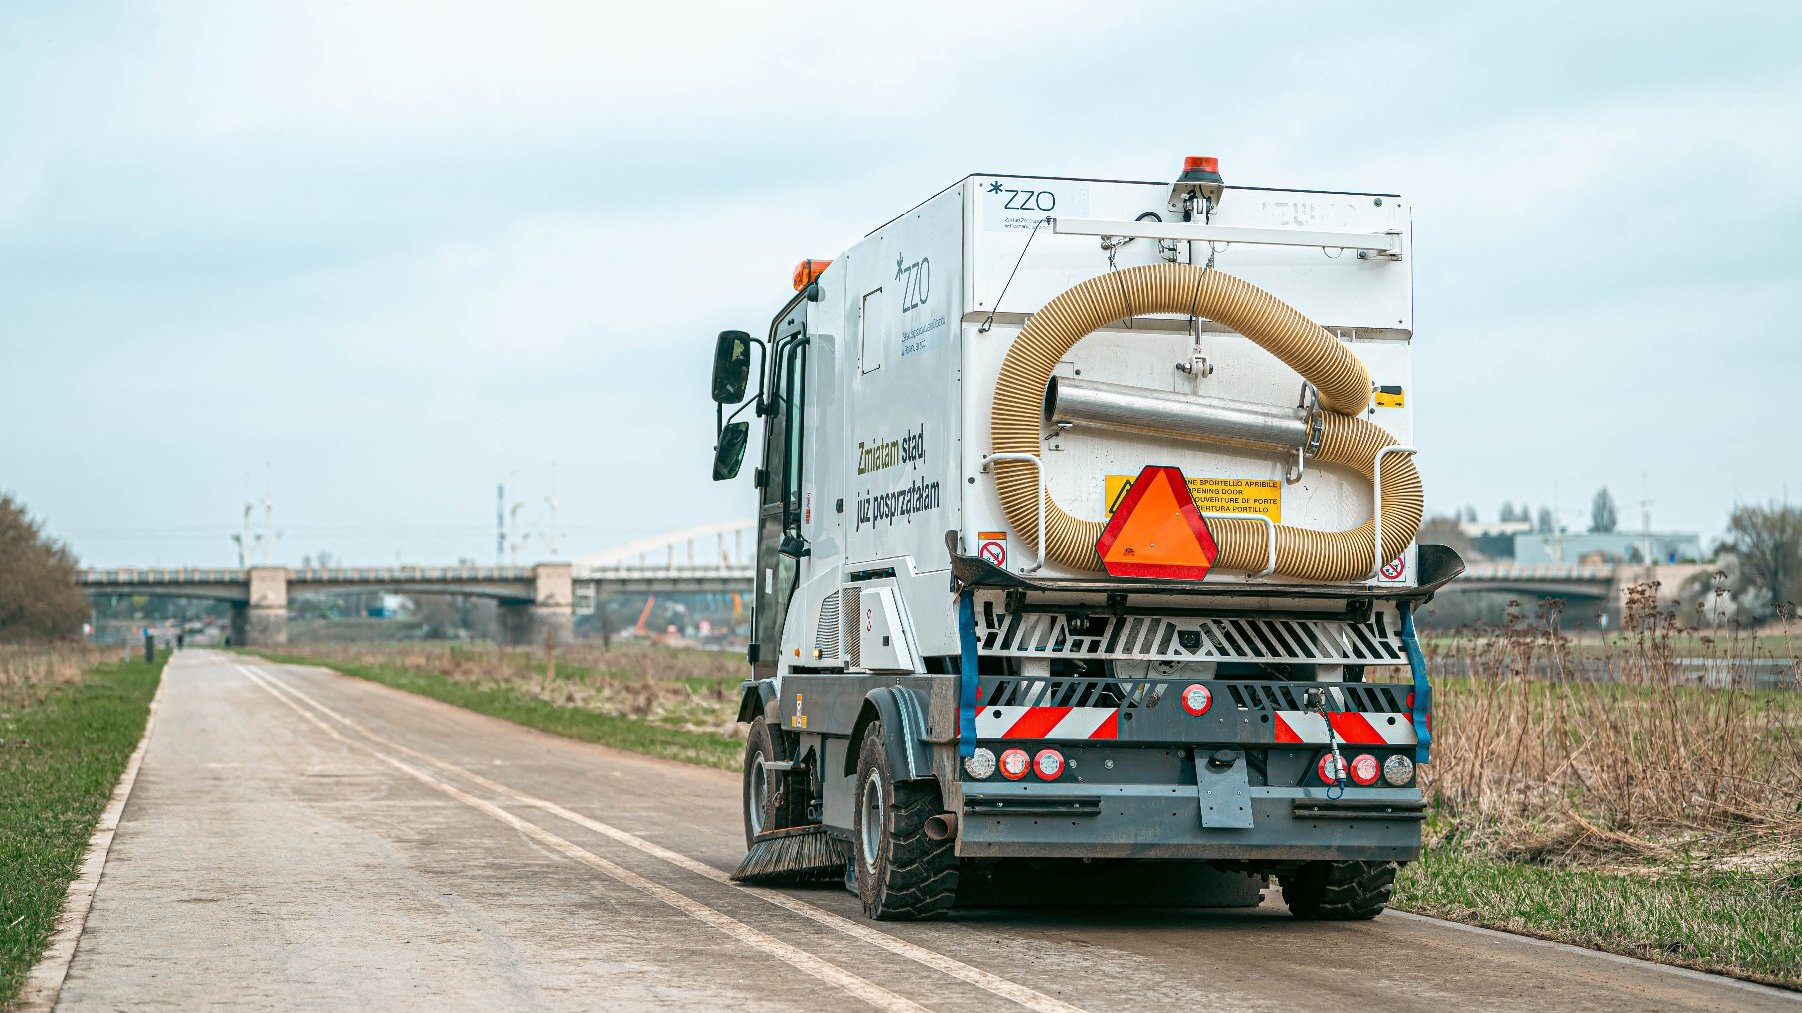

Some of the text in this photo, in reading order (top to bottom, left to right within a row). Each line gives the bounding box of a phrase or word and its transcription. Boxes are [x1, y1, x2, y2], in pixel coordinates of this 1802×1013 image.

[1004, 190, 1055, 211] ZZO
[903, 257, 930, 313] ZZO
[858, 423, 925, 475] Zmiatam stąd,
[856, 476, 939, 532] już posprzątałam
